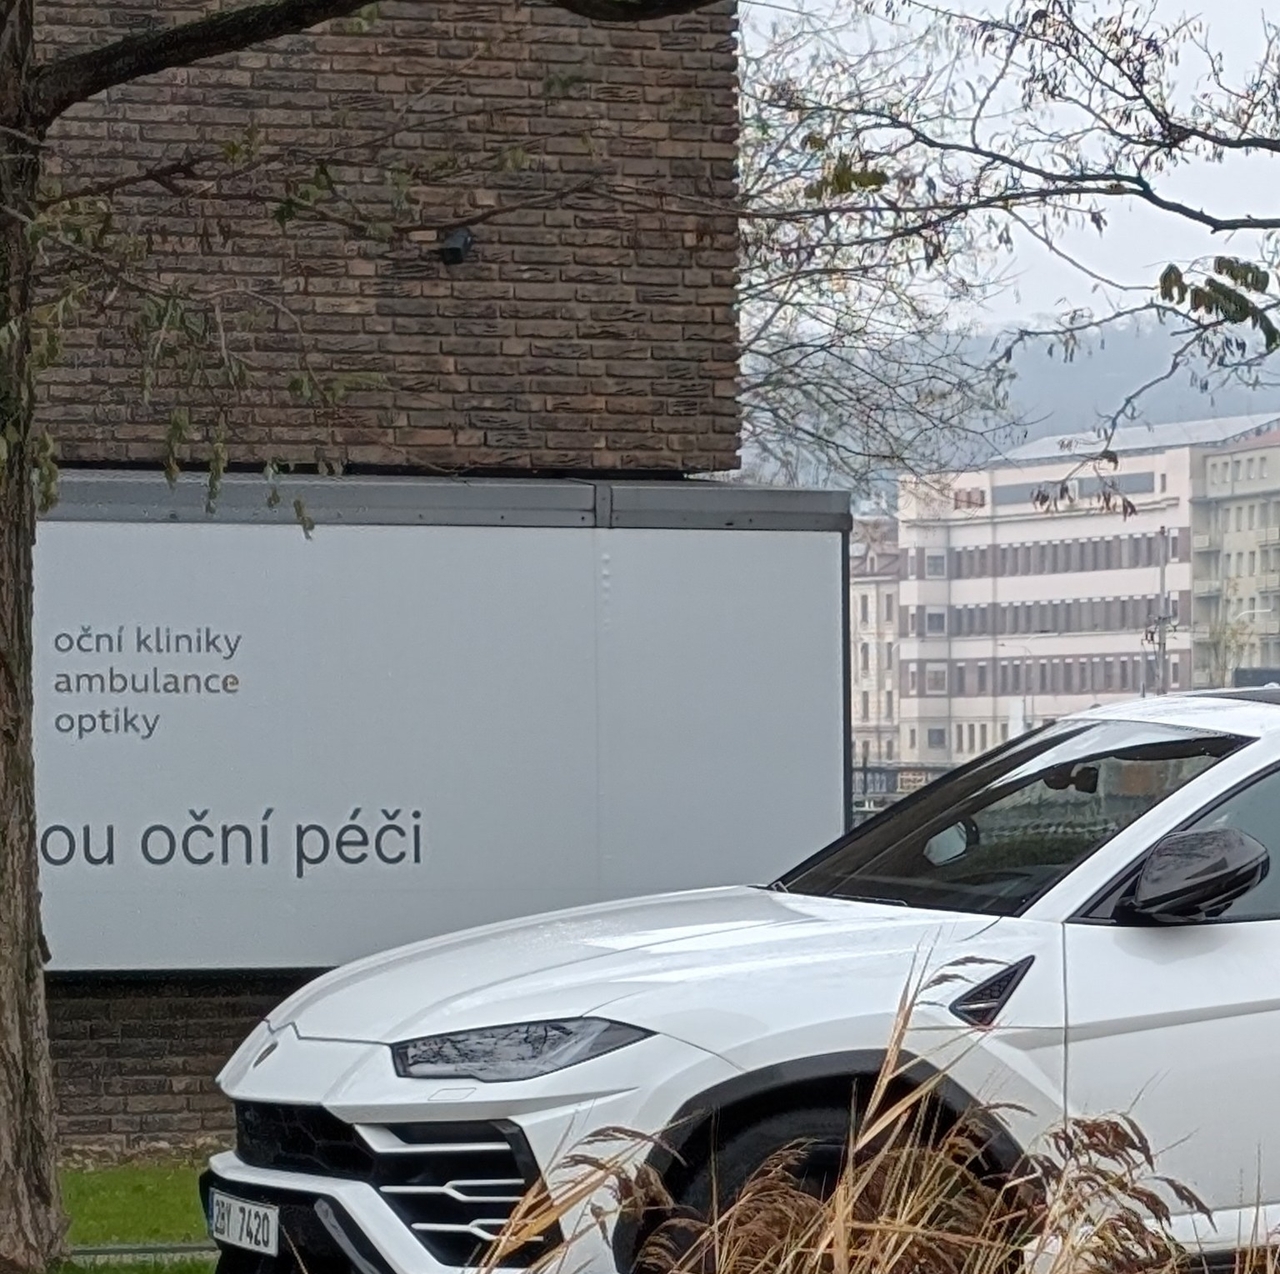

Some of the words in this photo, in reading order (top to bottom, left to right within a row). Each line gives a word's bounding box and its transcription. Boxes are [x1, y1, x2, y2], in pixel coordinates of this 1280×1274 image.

[54, 626, 125, 654] oční
[136, 627, 242, 660] kliniky
[54, 667, 240, 694] ambulance
[54, 707, 161, 740] optiky
[140, 807, 274, 866] oční
[295, 807, 423, 879] péči
[239, 1206, 270, 1247] 7420
